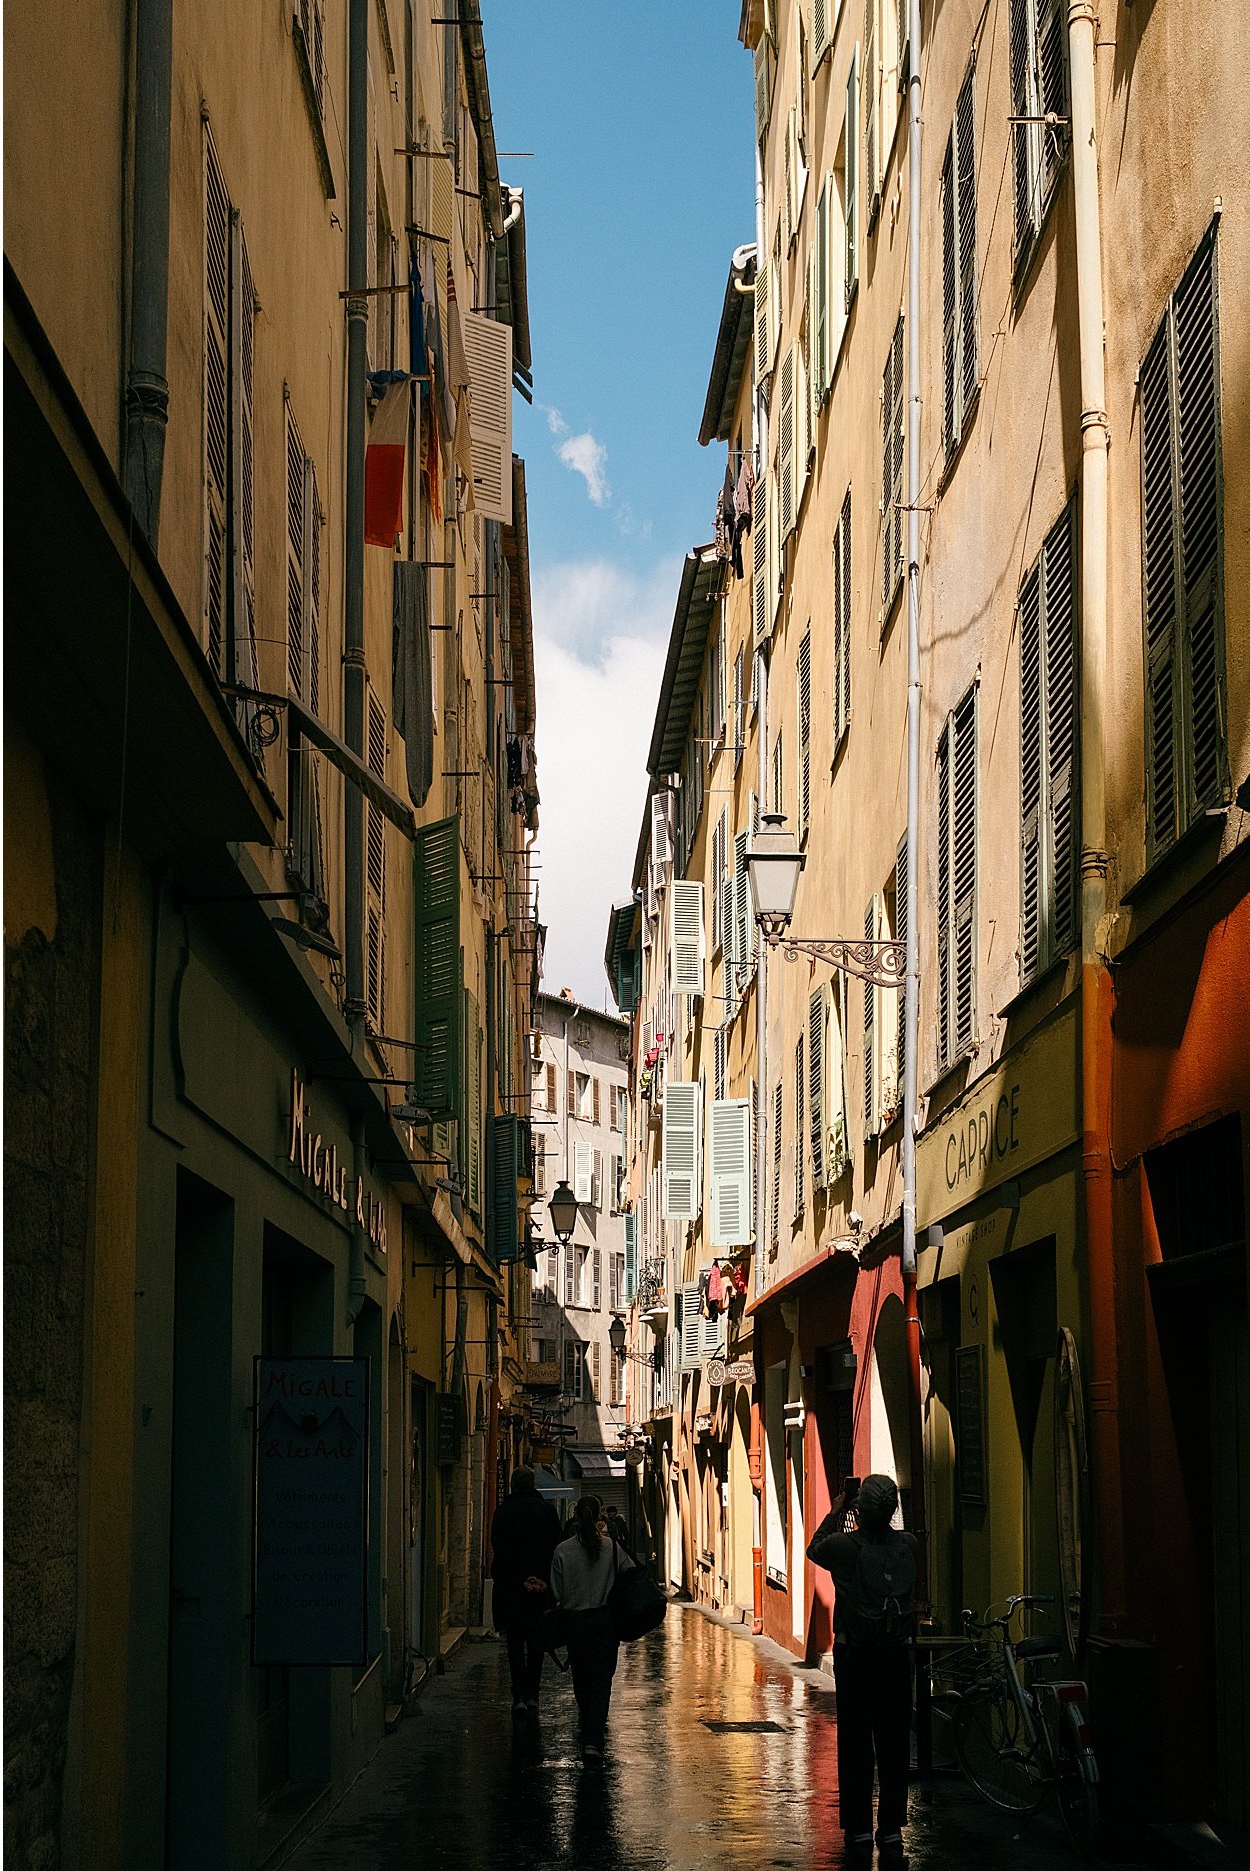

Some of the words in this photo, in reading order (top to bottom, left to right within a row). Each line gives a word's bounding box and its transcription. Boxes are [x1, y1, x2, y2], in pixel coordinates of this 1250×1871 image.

[945, 1084, 1020, 1190] CAPRICE
[956, 1226, 979, 1247] VINTAGE
[980, 1218, 996, 1238] SHOP
[728, 1366, 754, 1375] BROCANTE
[266, 1439, 284, 1460] &
[287, 1439, 312, 1459] Les
[315, 1439, 354, 1460] Arts
[267, 1516, 350, 1531] Accessoires
[262, 1543, 303, 1559] Bijoux
[305, 1543, 316, 1556] &
[316, 1542, 358, 1559] Objets
[271, 1569, 288, 1582] de
[292, 1569, 348, 1583] Création
